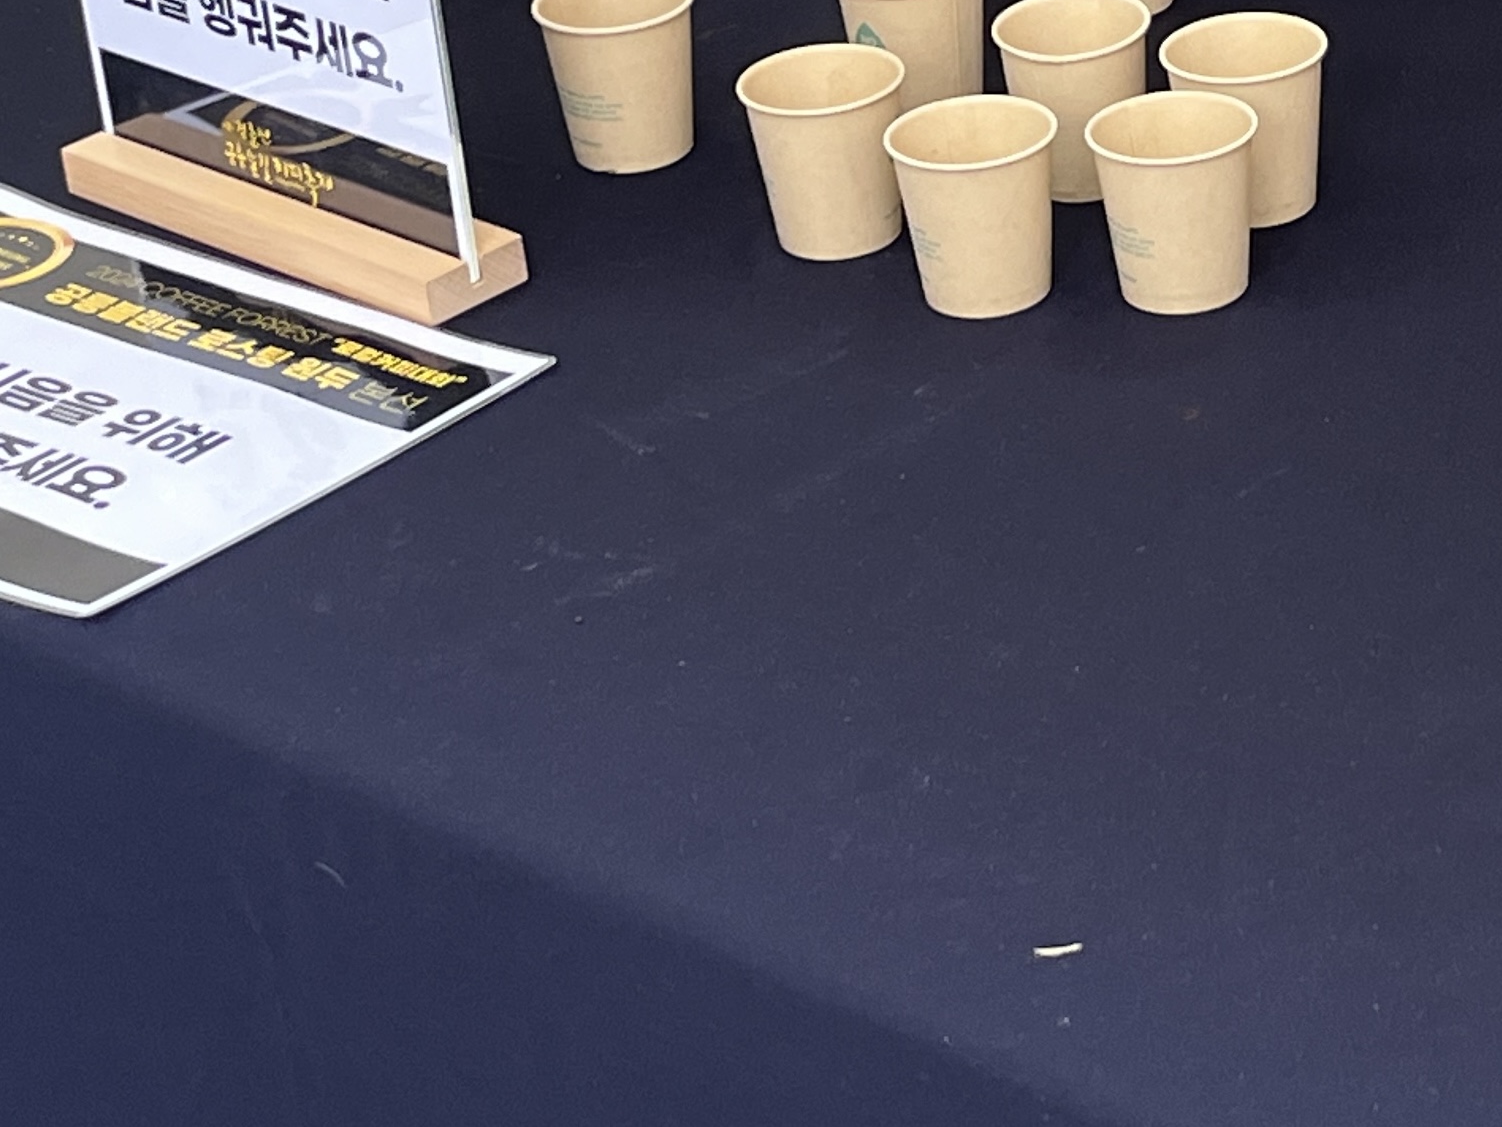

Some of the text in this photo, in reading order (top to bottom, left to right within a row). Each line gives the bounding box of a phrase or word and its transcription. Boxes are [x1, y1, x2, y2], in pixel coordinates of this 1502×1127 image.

[187, 328, 295, 369] 로스팅
[281, 357, 361, 390] 원두
[102, 409, 233, 464] 위해
